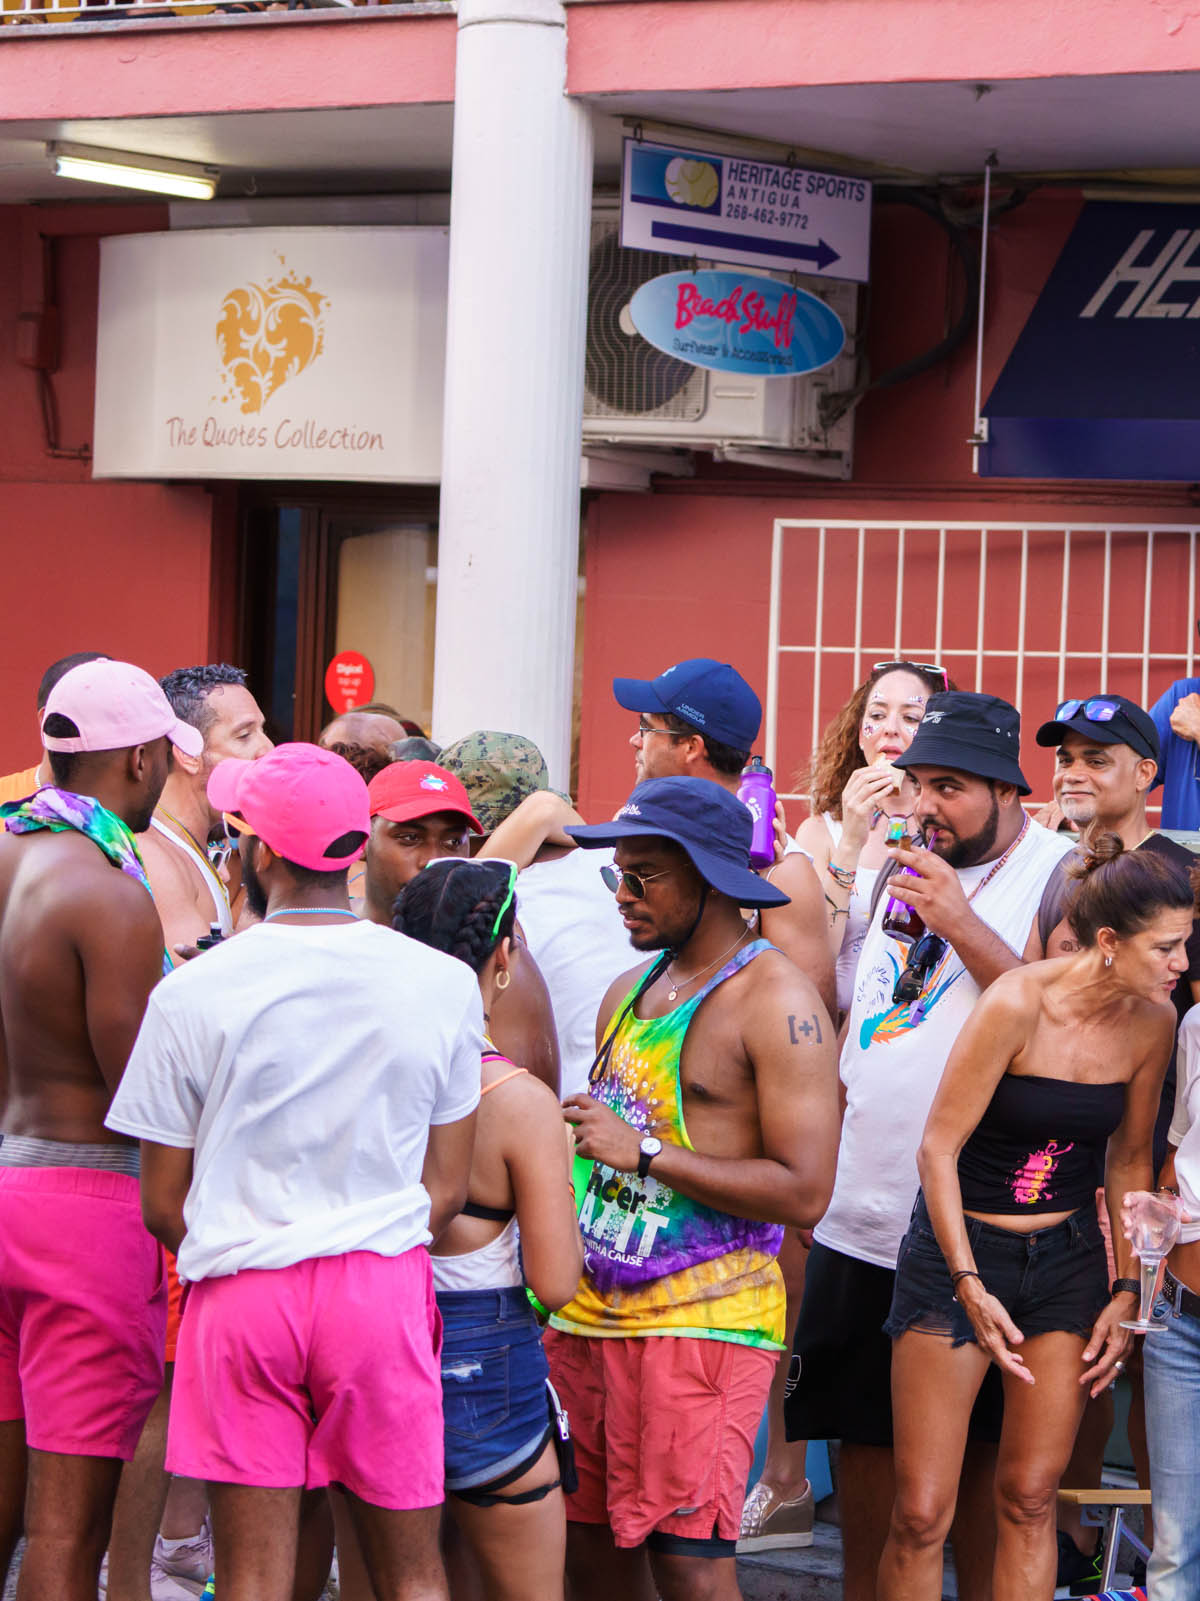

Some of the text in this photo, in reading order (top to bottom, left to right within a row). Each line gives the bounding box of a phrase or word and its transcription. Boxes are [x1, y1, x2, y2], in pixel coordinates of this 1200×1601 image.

[727, 161, 866, 202] HERITAGE SPORTS
[726, 185, 801, 209] ANTIGUA
[726, 203, 809, 230] 268-462-9772
[674, 282, 798, 349] Beach Stuff
[165, 416, 385, 451] The Quotes Collection
[675, 706, 706, 725] ARMOUR
[681, 703, 705, 720] UNDER
[607, 1249, 644, 1268] CAUSE
